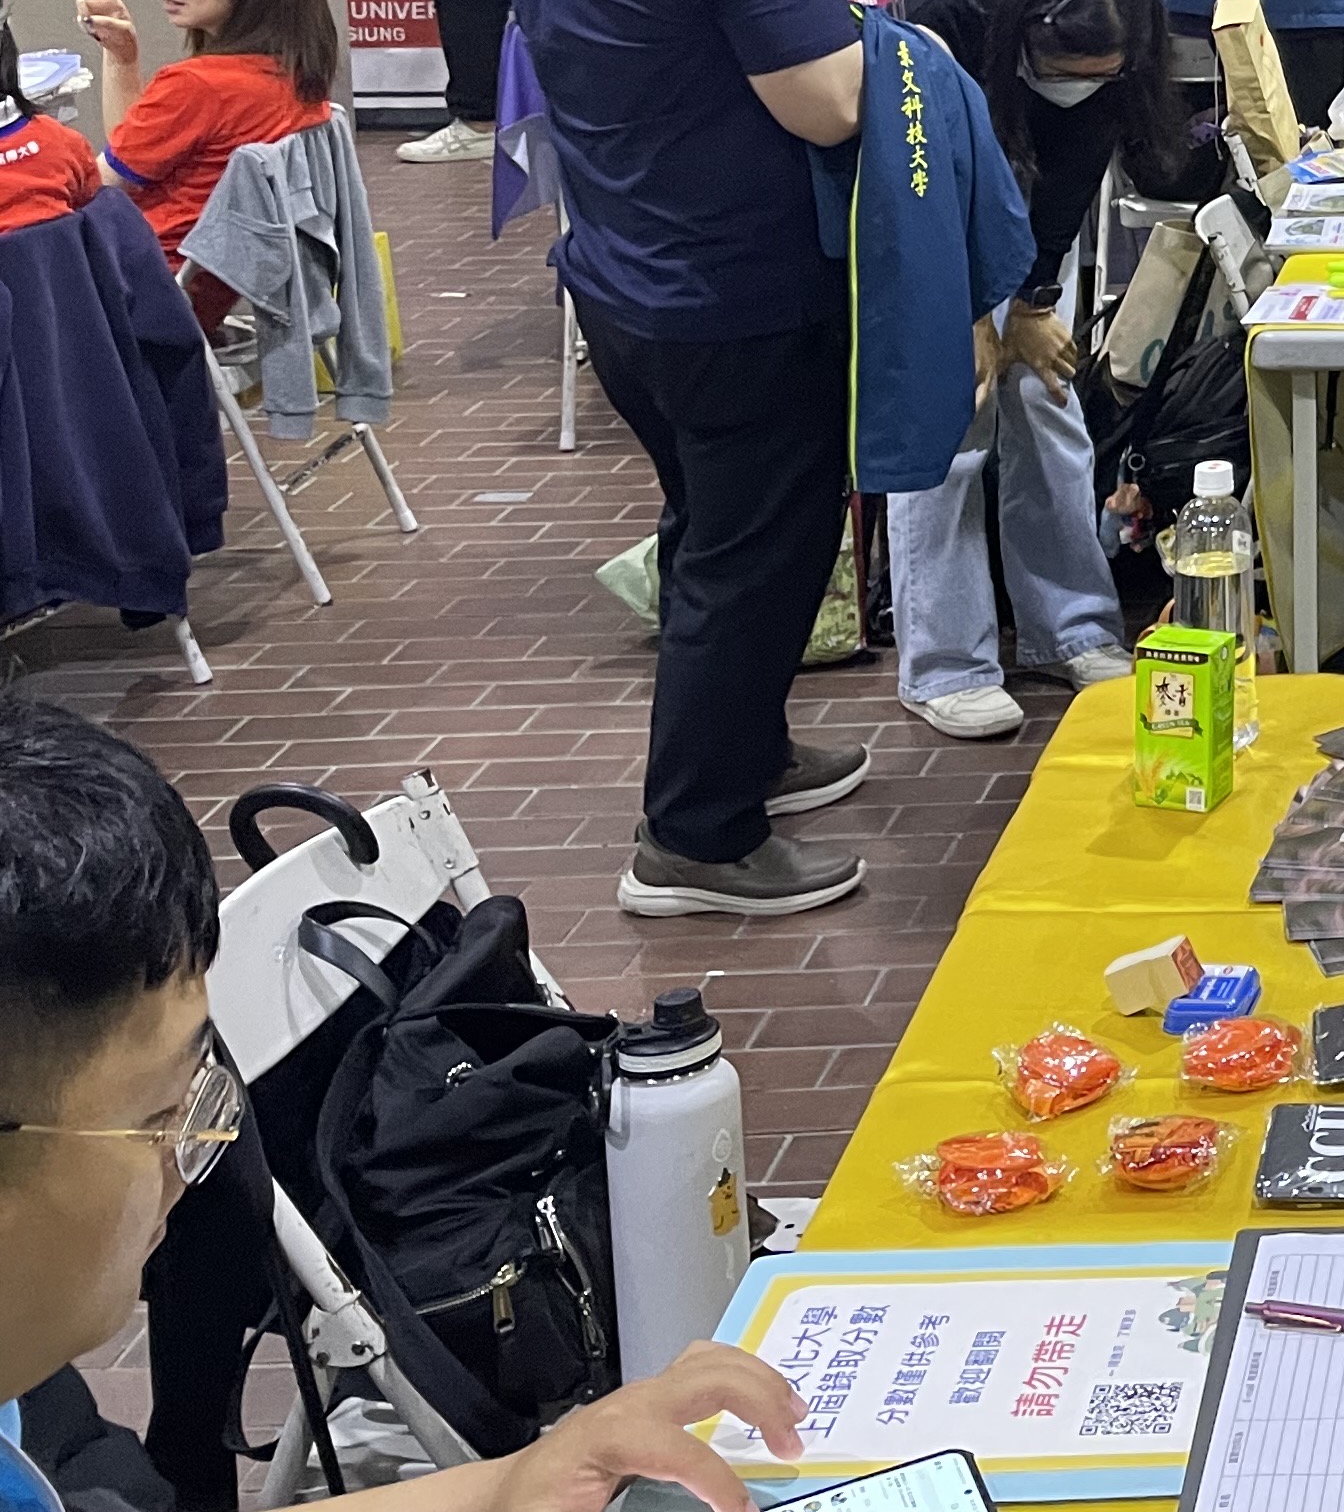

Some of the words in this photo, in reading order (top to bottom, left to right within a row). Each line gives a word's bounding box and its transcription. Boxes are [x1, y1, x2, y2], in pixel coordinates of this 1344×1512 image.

[897, 40, 929, 198] 景文科技大學
[799, 1305, 891, 1439] 上屆錄取分數
[876, 1314, 951, 1426] 分數僅供參考
[1011, 1314, 1087, 1418] 請勿帶走
